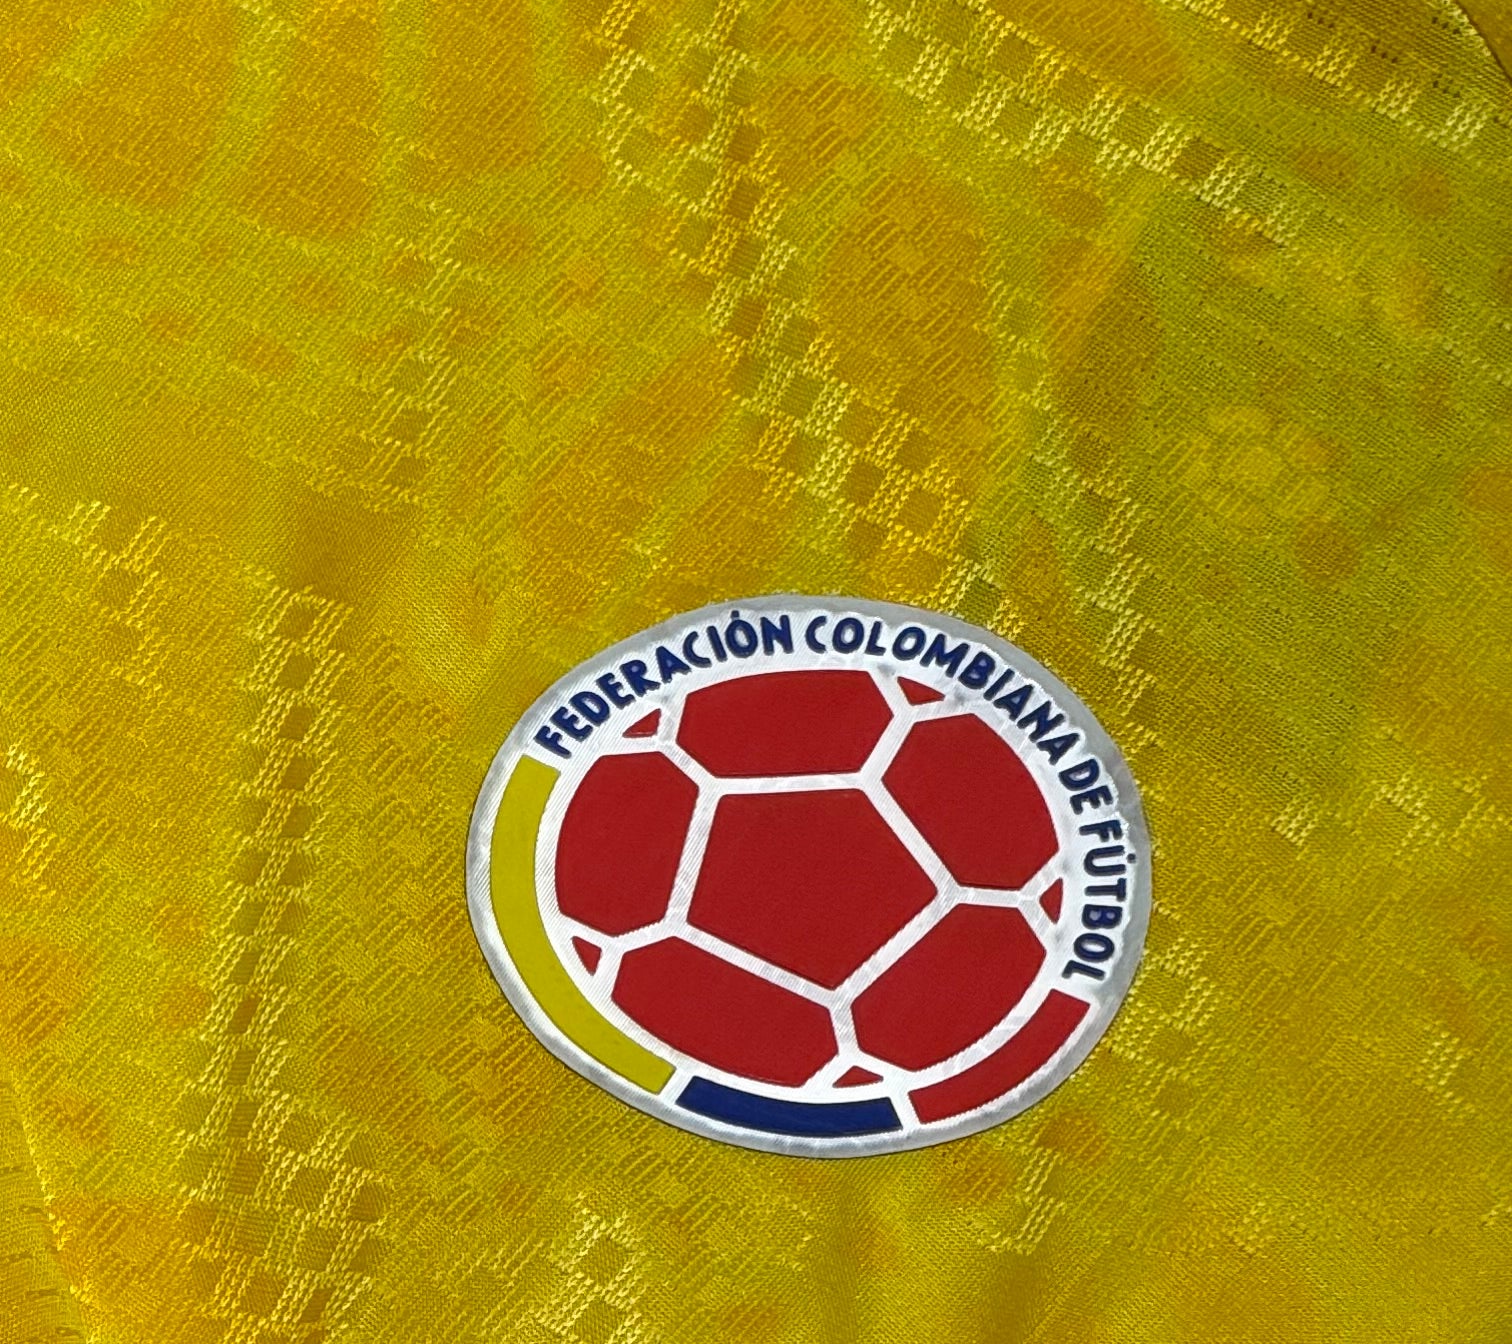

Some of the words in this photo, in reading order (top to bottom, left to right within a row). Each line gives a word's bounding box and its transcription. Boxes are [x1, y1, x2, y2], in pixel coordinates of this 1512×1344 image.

[533, 610, 794, 759] FEDERACIÓN
[806, 615, 1080, 764] COLOMBIANA
[1058, 757, 1112, 814] DE
[1063, 816, 1136, 981] FÚTBOL
